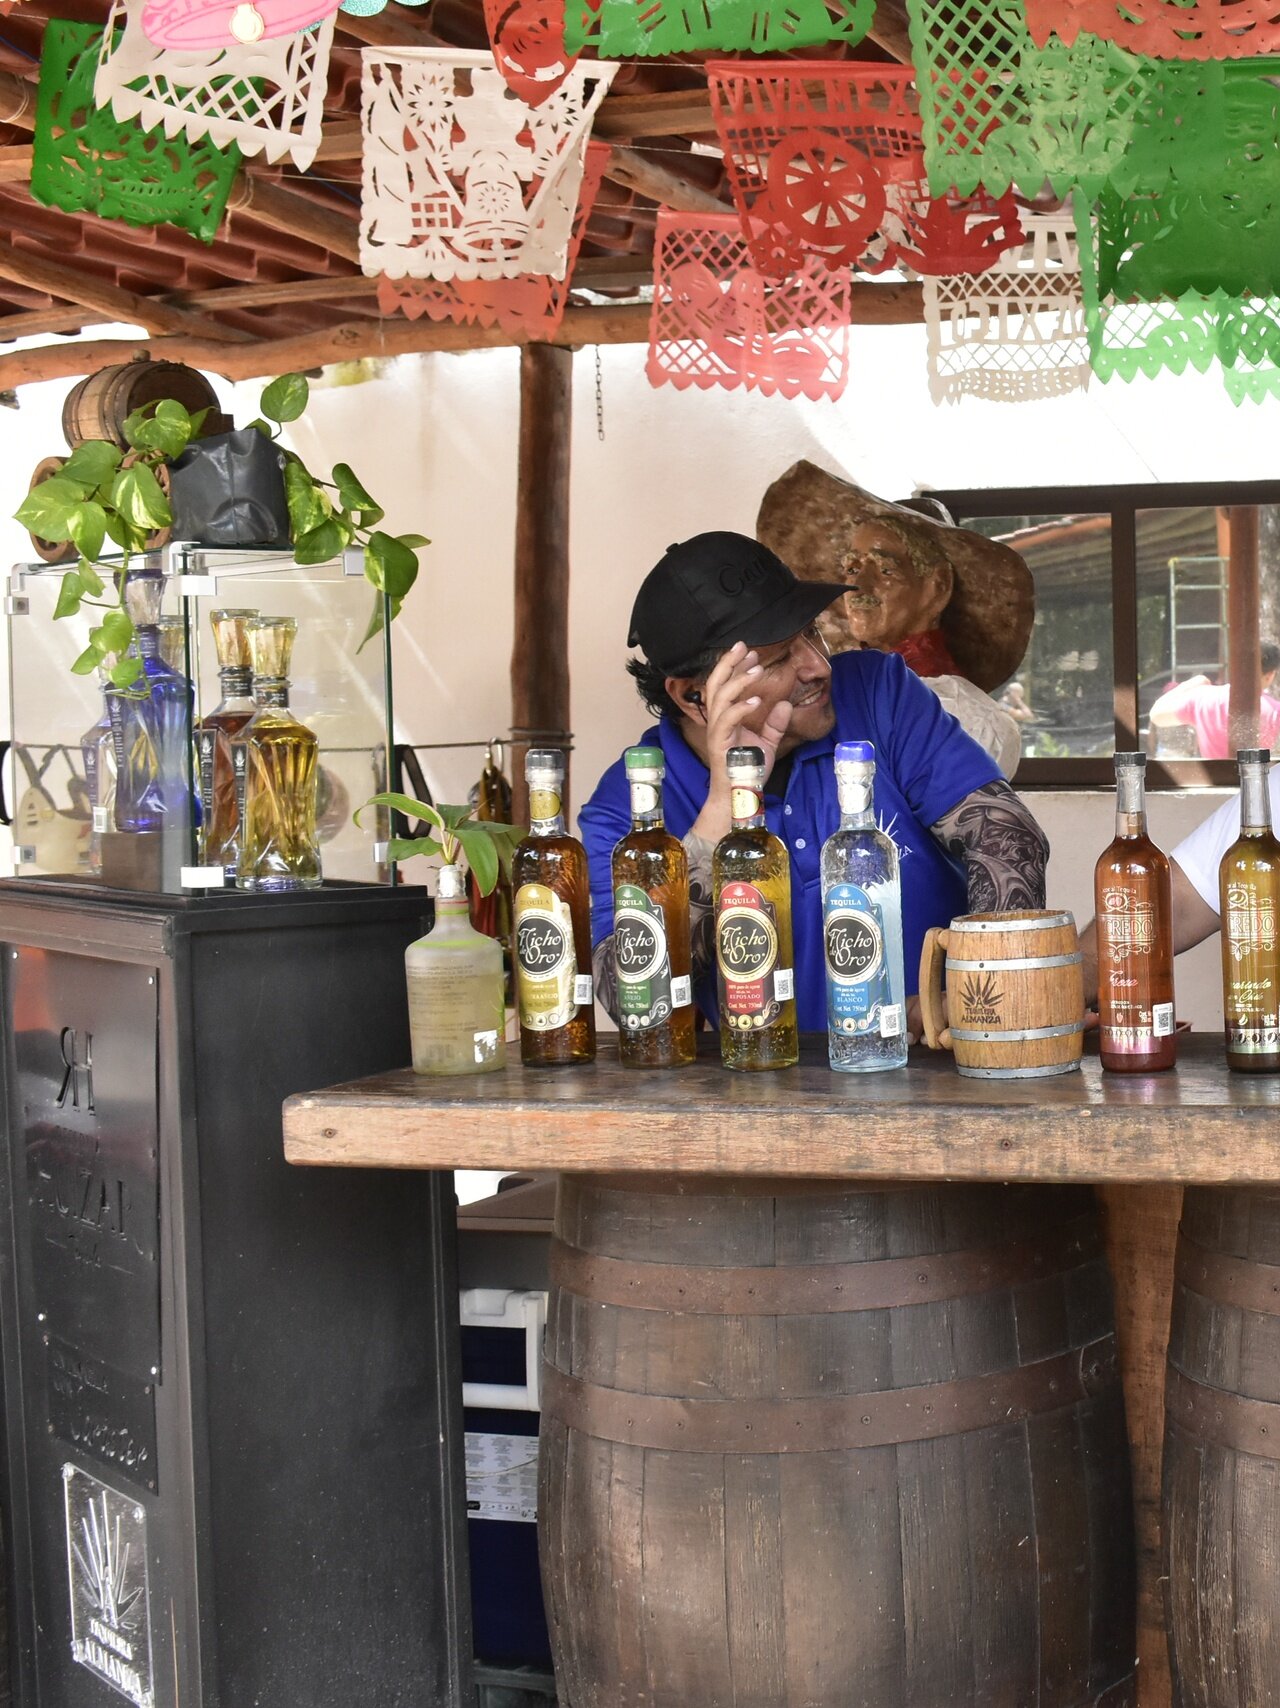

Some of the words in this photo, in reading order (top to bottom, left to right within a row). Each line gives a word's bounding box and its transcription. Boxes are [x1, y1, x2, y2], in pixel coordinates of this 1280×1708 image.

[1105, 919, 1153, 936] CREDO
[1229, 917, 1275, 933] CREDO
[525, 946, 556, 964] Oro
[621, 946, 648, 964] Oro
[729, 945, 761, 964] Oro
[835, 947, 867, 966] Oro
[961, 1015, 1001, 1024] ALMANZA
